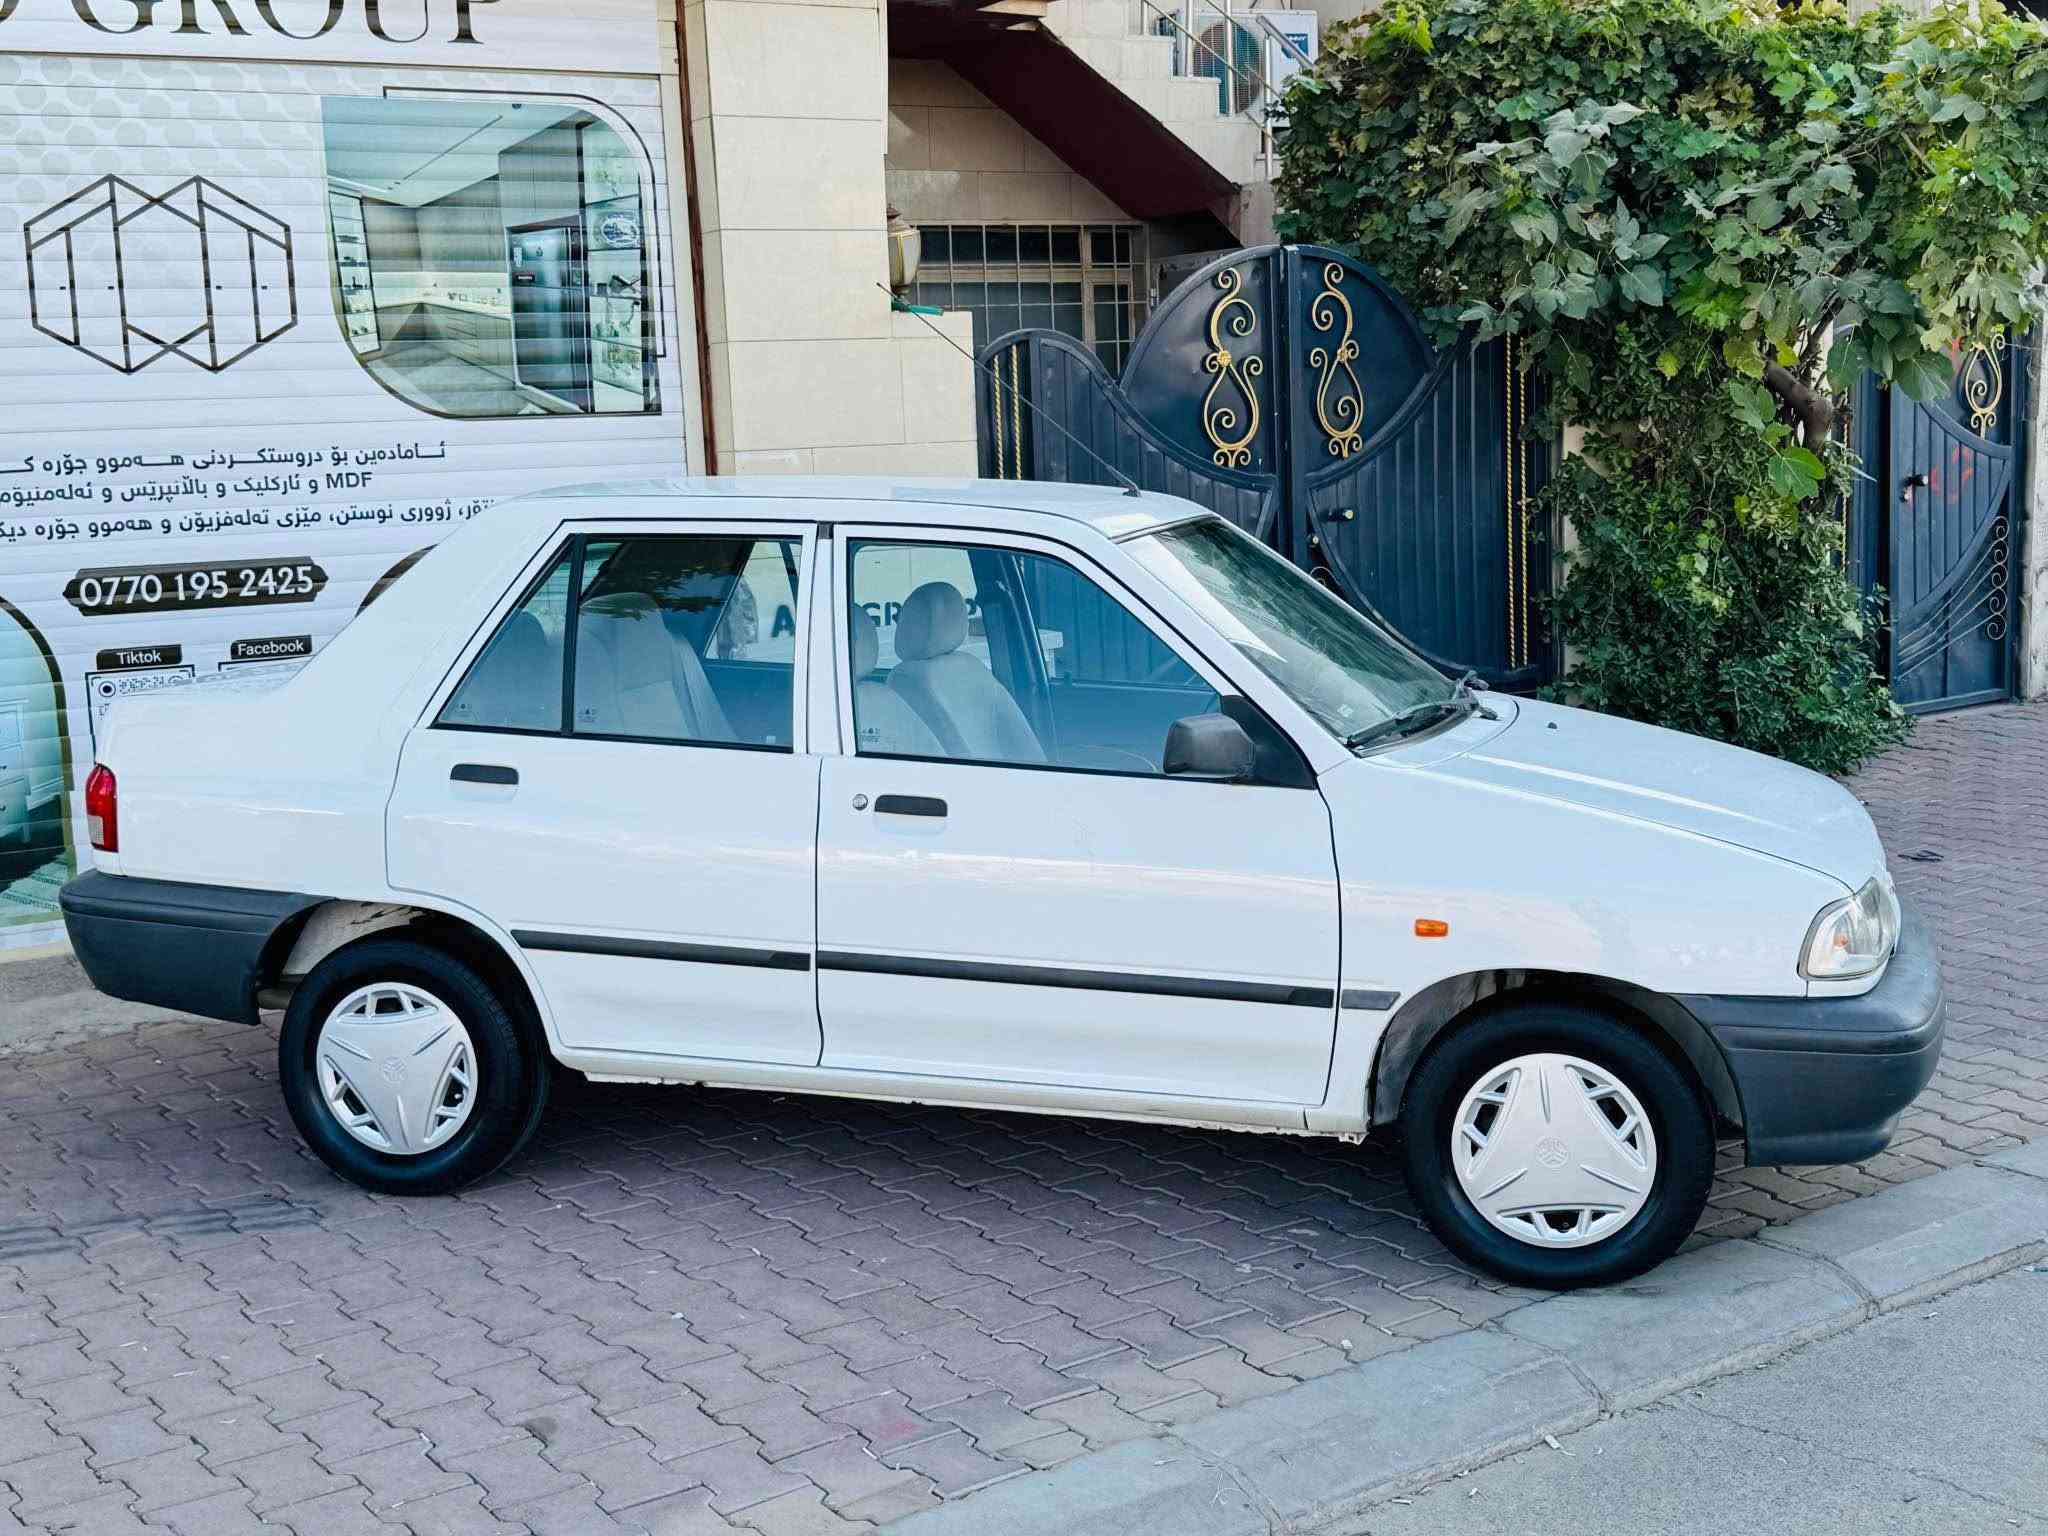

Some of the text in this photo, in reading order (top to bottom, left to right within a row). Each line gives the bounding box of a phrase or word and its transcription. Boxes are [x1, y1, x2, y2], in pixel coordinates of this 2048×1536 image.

[308, 478, 319, 495] و
[326, 470, 374, 490] MDF
[101, 486, 113, 504] و
[215, 482, 227, 498] و
[160, 518, 172, 535] و
[79, 565, 314, 607] 0770 195 2425
[238, 639, 305, 656] Facebook
[116, 649, 163, 665] Tiktok
